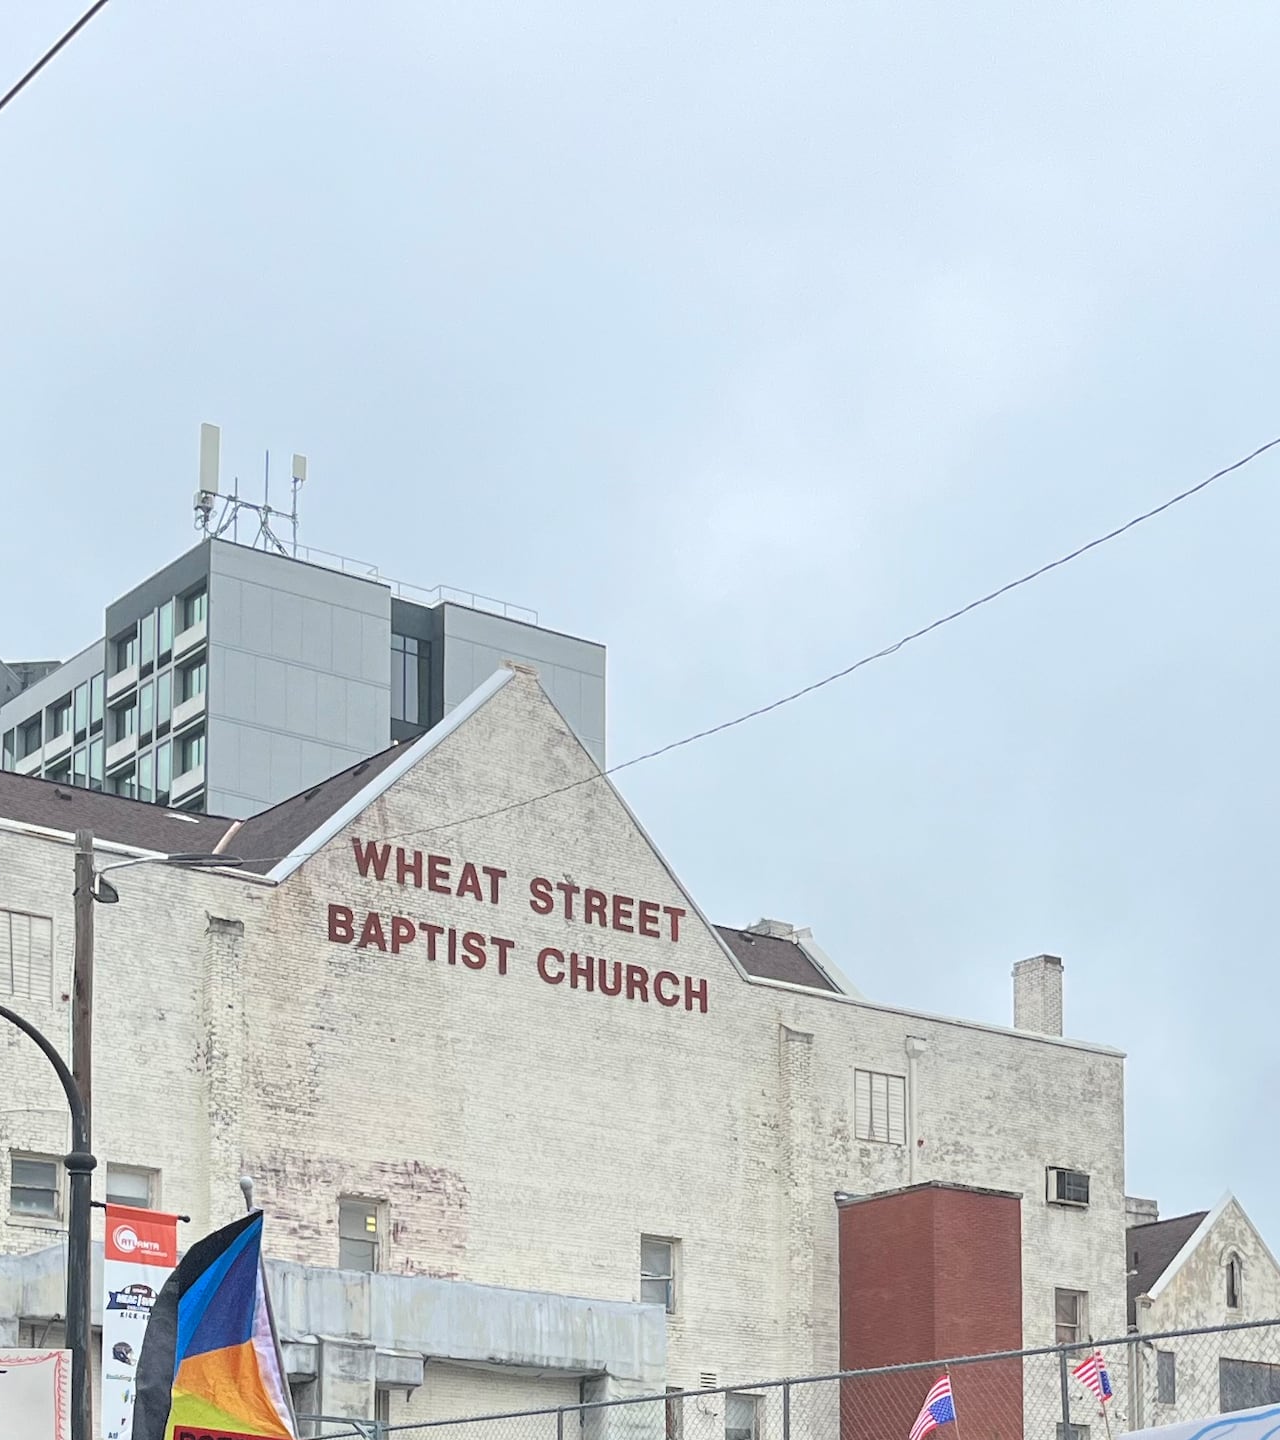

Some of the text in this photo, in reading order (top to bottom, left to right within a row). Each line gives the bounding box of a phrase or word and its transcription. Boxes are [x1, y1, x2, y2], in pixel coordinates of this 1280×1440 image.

[352, 837, 686, 943] WHEAT STREET
[328, 903, 708, 1014] BAPTIST CHURCH
